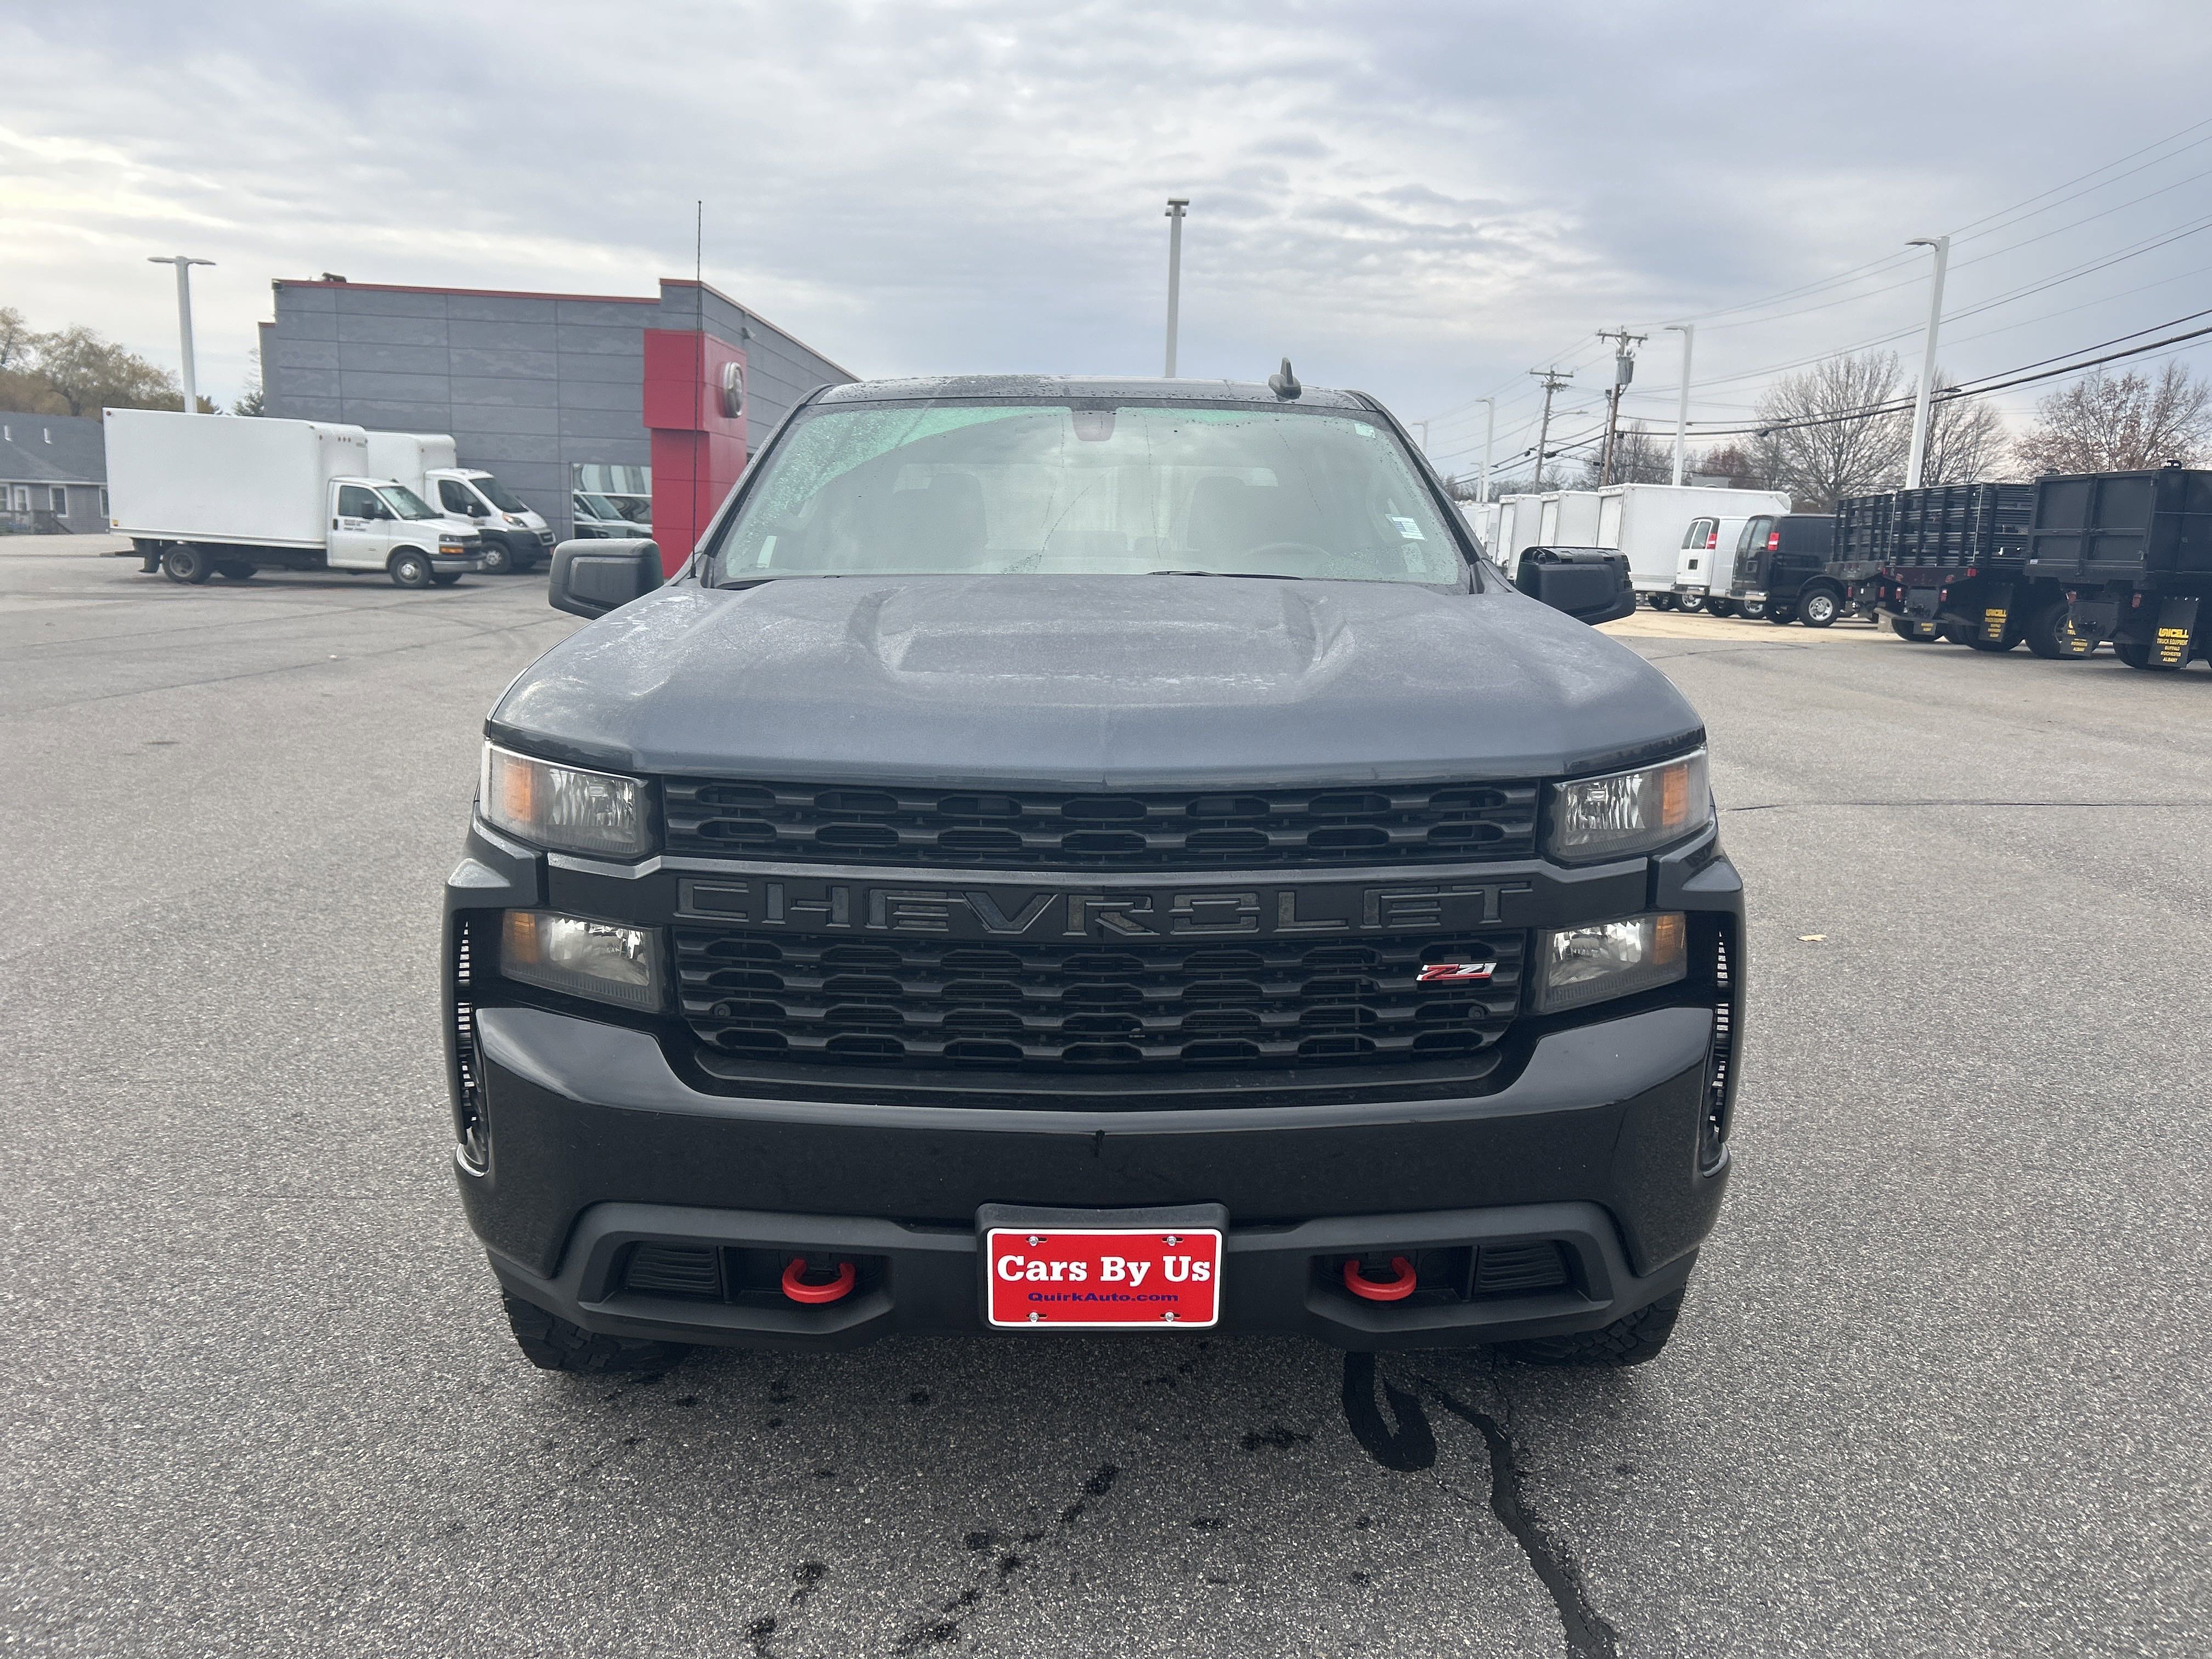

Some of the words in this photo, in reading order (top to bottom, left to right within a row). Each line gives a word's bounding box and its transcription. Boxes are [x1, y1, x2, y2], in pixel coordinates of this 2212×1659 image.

[673, 877, 1533, 936] CHEVROLET
[996, 1255, 1087, 1282] Cars
[1100, 1256, 1151, 1286] By
[1163, 1255, 1211, 1282] Us
[1028, 1292, 1179, 1302] QuirkAuto.com
